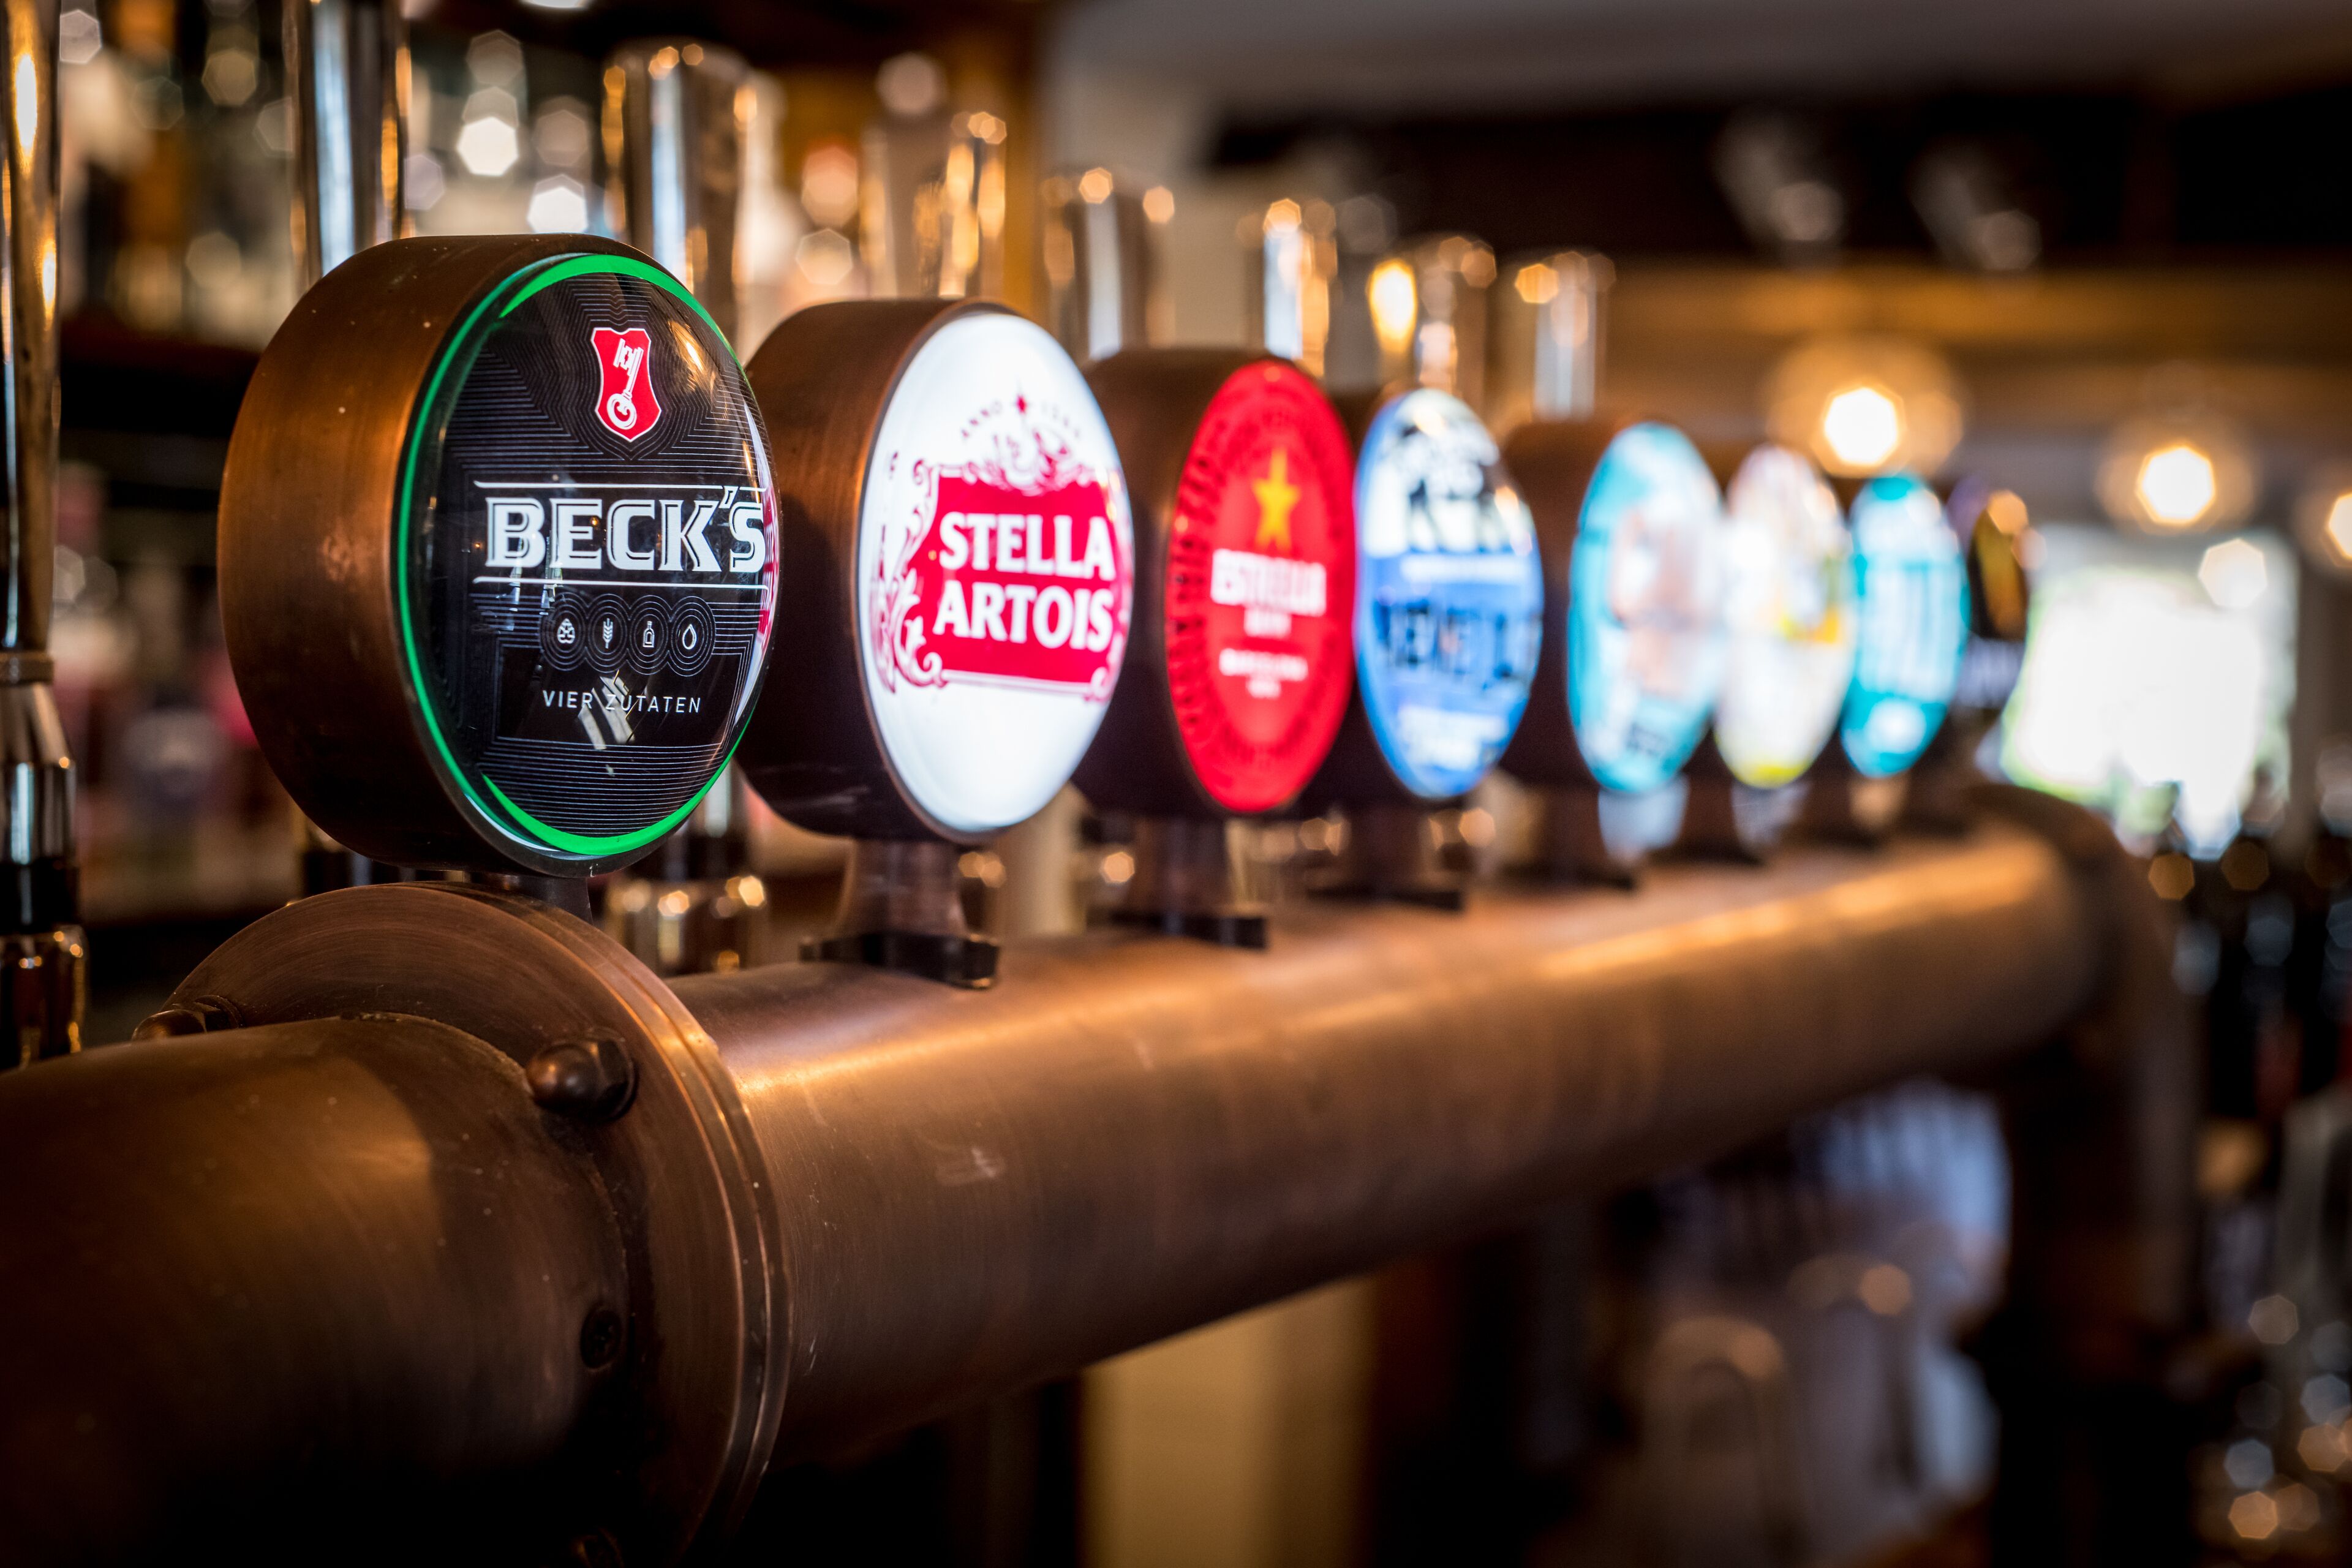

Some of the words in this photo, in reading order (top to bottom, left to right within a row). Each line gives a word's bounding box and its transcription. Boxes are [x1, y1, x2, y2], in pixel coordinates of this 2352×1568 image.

[484, 486, 766, 573] BECK'S
[939, 511, 1117, 581] STELLA
[932, 579, 1114, 659] ARTOIS
[542, 690, 594, 709] VIER
[605, 694, 701, 714] ZUTATEN
